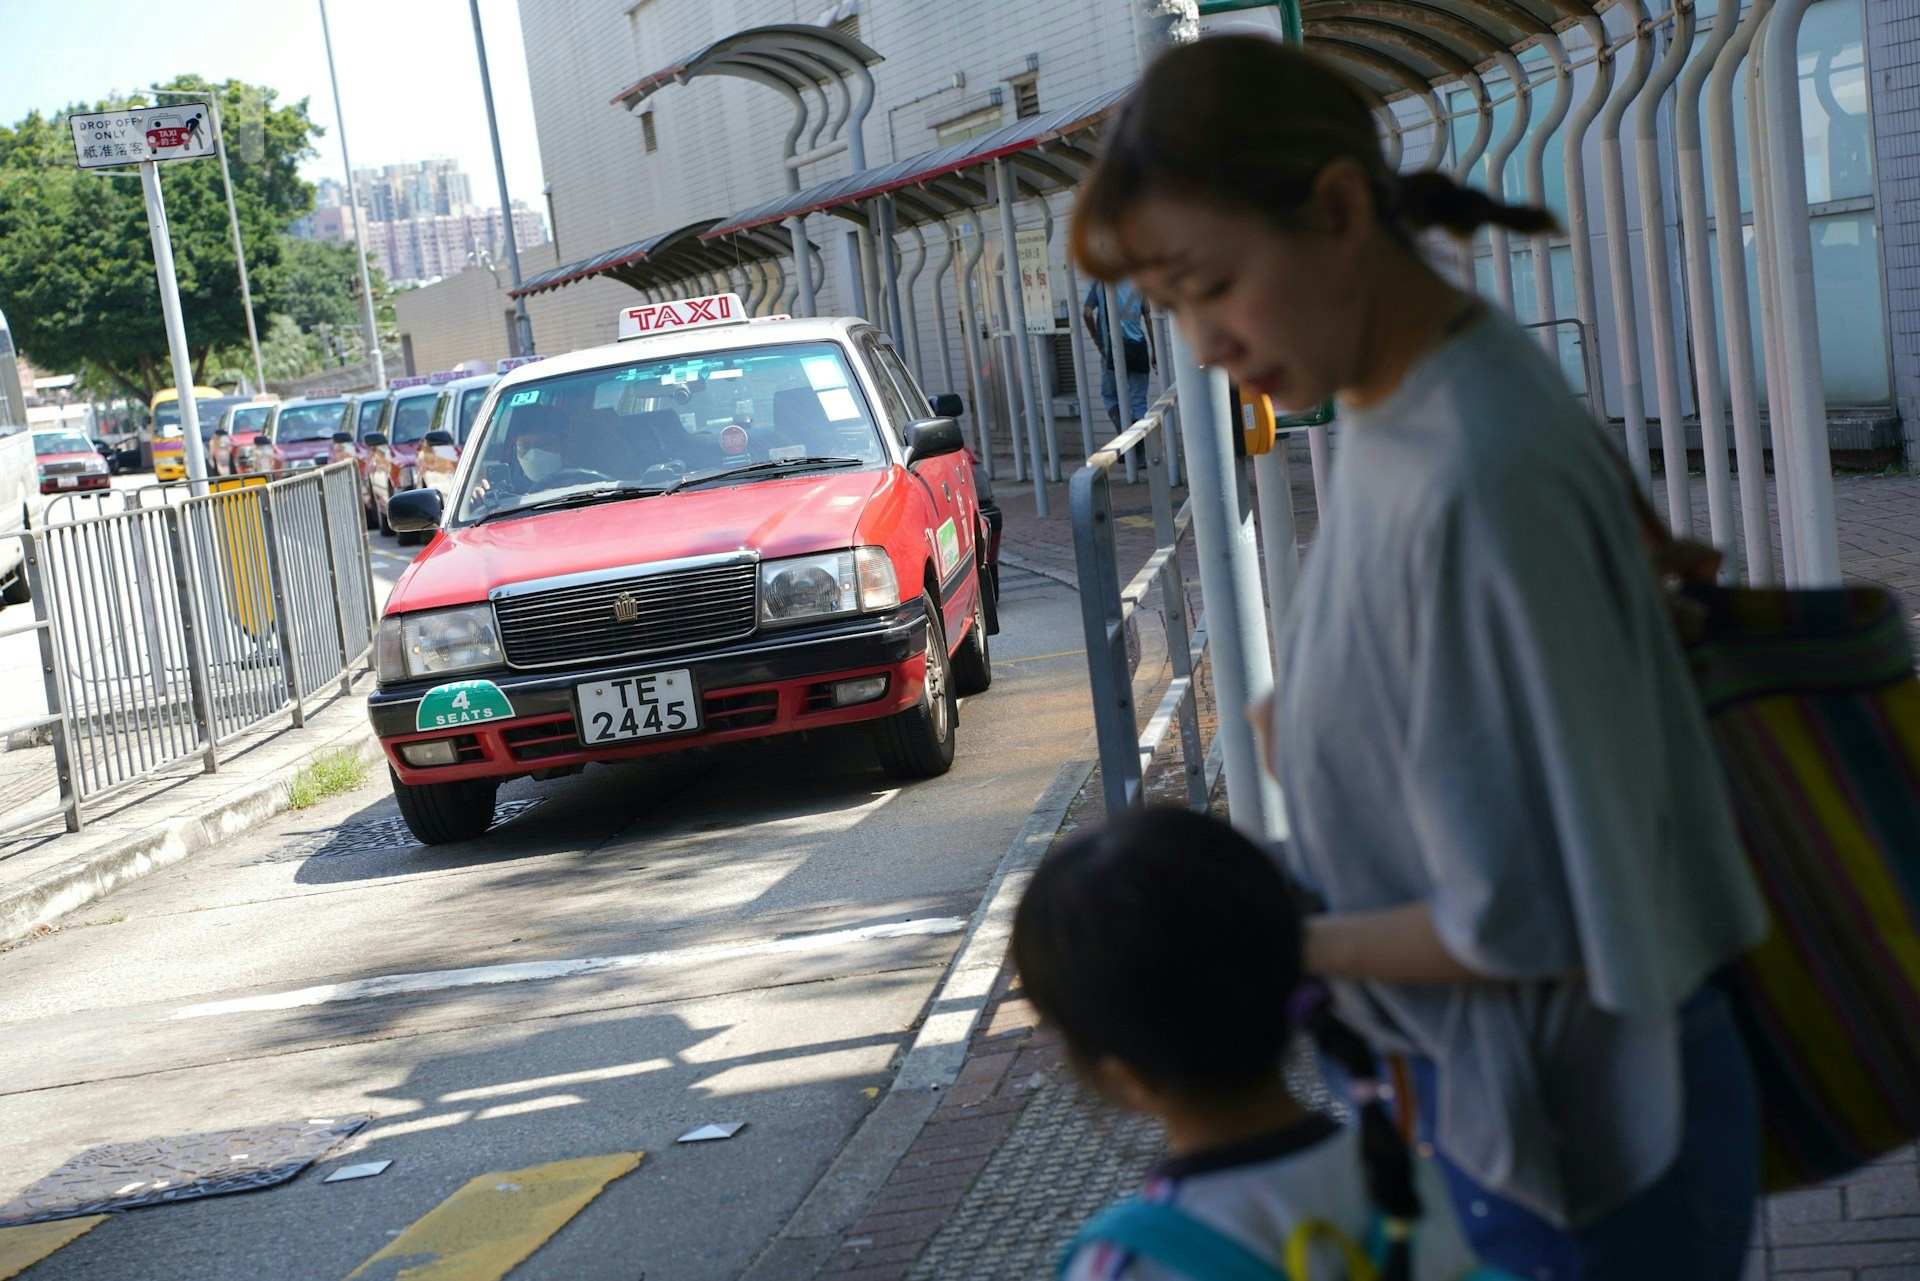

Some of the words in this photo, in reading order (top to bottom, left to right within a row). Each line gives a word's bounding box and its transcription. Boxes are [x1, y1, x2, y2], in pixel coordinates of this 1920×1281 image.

[80, 120, 111, 131] DROP
[115, 117, 137, 128] OFF
[94, 130, 126, 140] ONLY
[158, 129, 177, 138] TAXI
[160, 137, 177, 146] 的士
[629, 296, 731, 331] TAXI
[452, 690, 471, 710] 4
[611, 676, 659, 708] TE
[436, 708, 493, 725] SEATS
[592, 700, 687, 741] 2445
